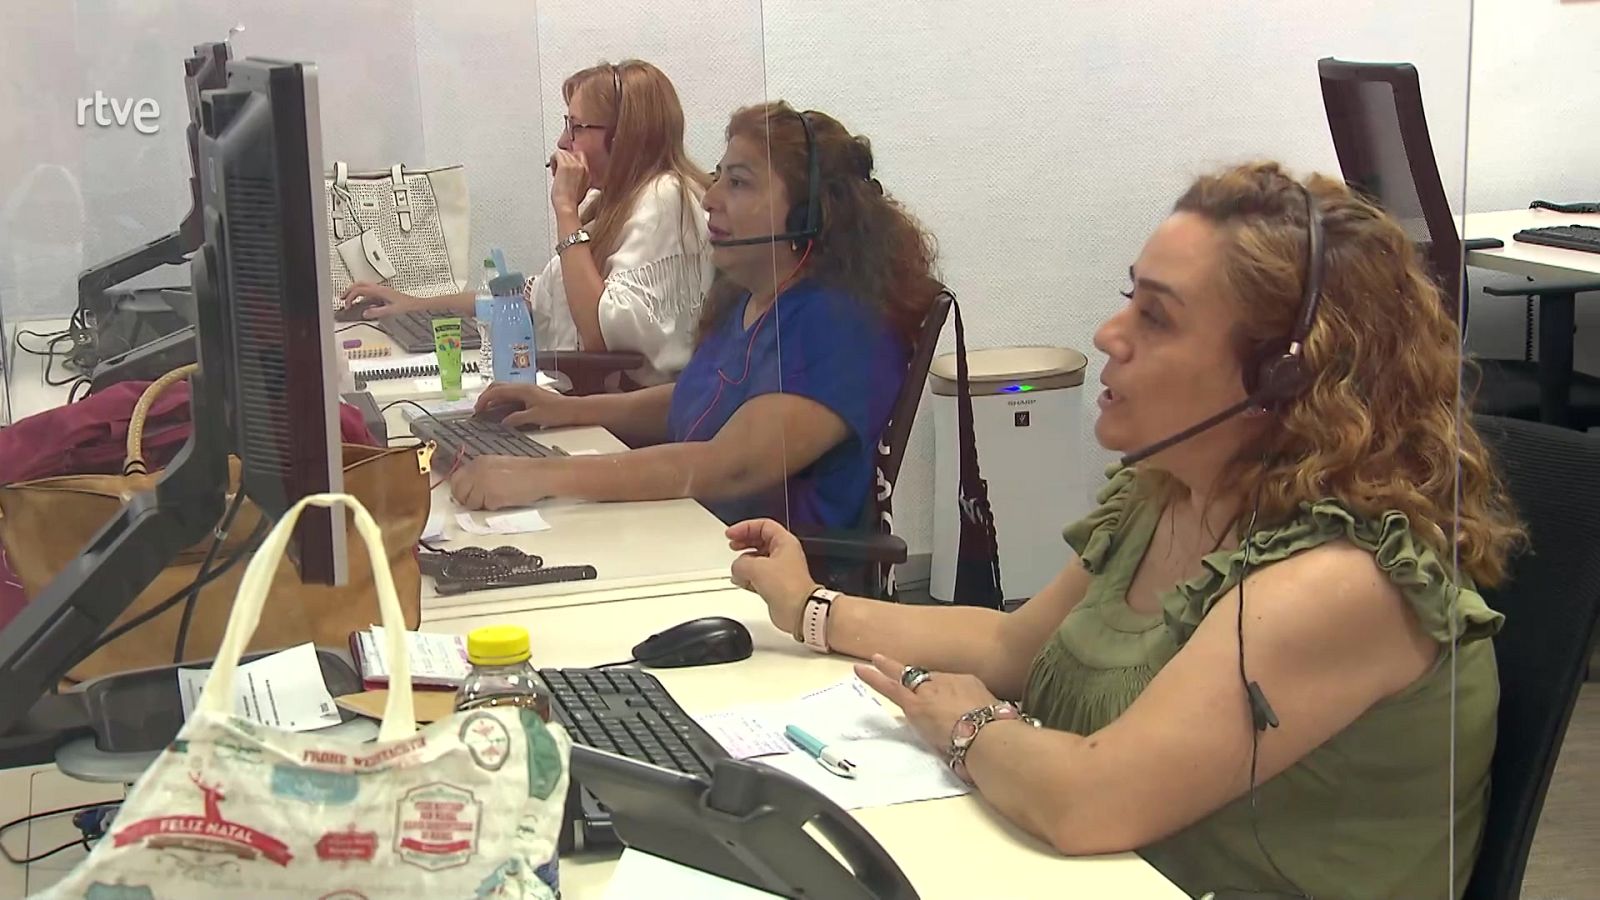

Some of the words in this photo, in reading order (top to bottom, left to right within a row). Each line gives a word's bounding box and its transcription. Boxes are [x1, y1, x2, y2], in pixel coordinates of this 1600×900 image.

[303, 749, 348, 765] FROHE
[159, 818, 204, 833] FELIZ
[204, 821, 254, 843] NATAL
